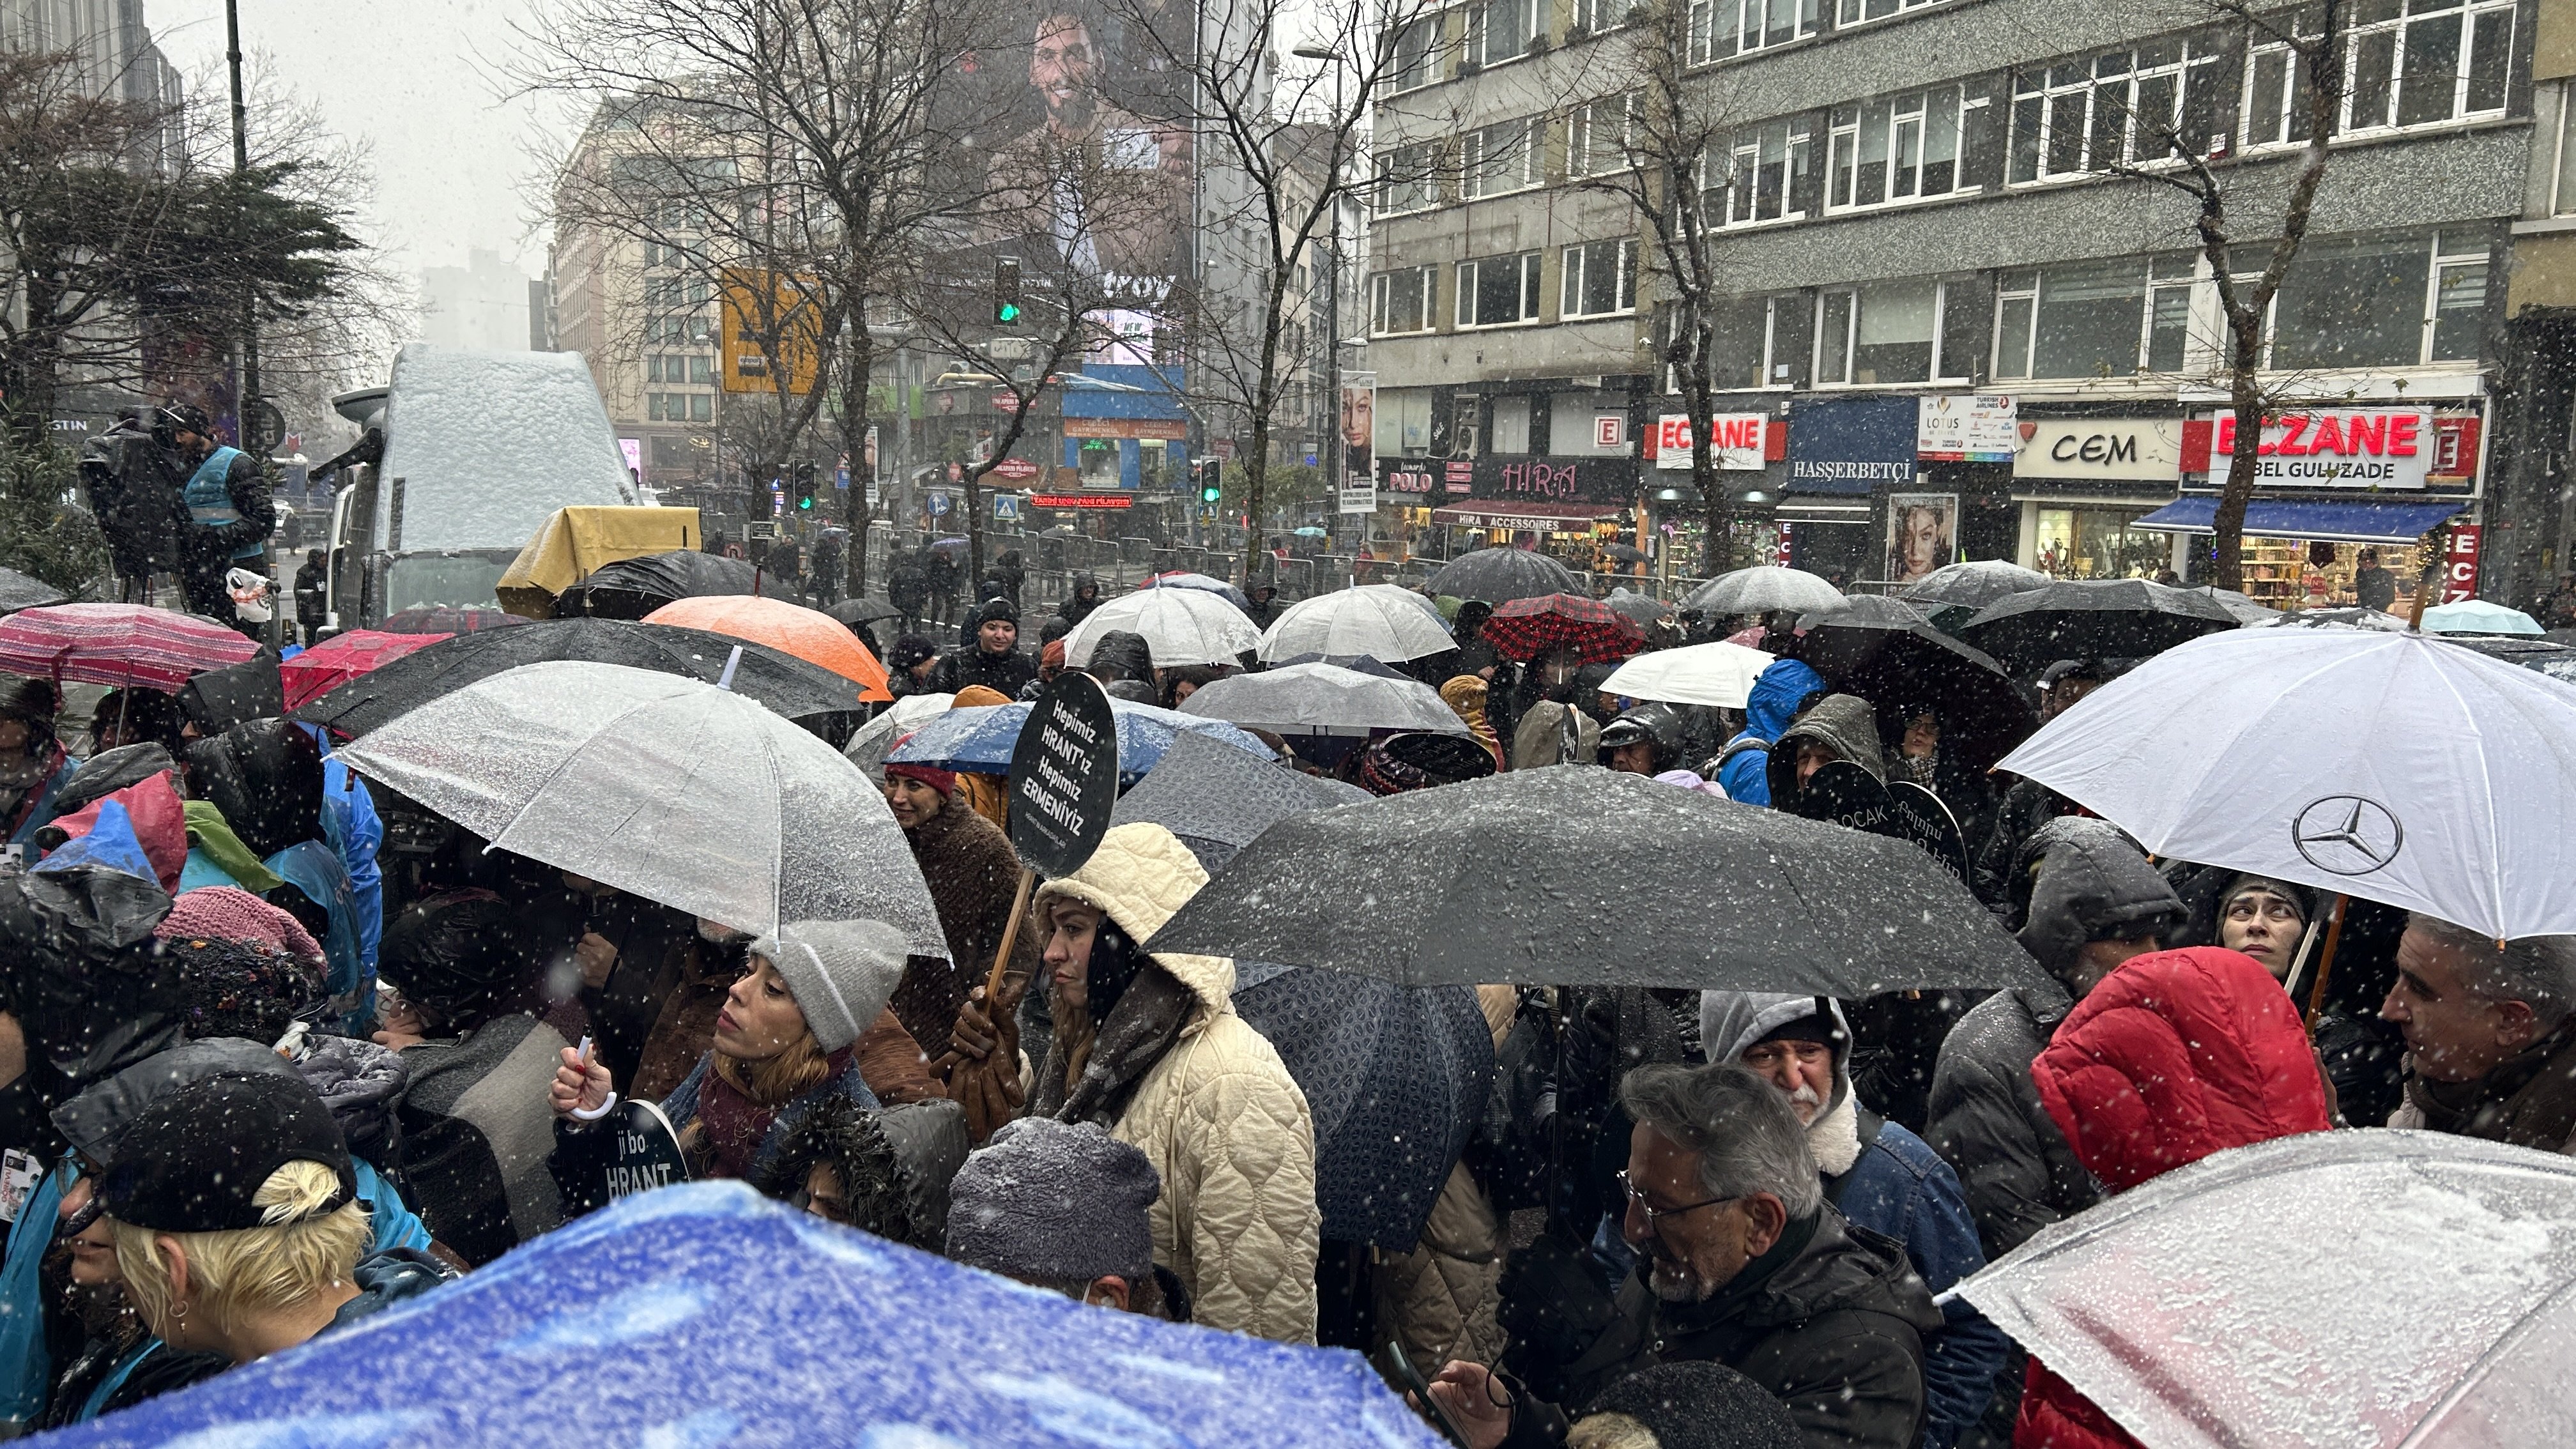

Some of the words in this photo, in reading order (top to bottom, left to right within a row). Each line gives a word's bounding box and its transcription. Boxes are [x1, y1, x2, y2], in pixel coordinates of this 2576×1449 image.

[1433, 422, 1445, 440] SALE
[1603, 423, 1614, 441] E
[1662, 420, 1759, 448] ECANE
[1927, 418, 1959, 429] LOTUS
[2051, 434, 2137, 466] CEM
[1390, 473, 1432, 493] POLO
[1794, 458, 1911, 483] HASŞERBETÇİ
[1053, 699, 1096, 744] Hepimiz
[1038, 755, 1082, 801] Hepimiz
[1023, 776, 1084, 836] ERMENİYİZ
[1842, 805, 1889, 829] OCAK
[627, 1130, 646, 1154] bo
[606, 1163, 671, 1201] HRANT
